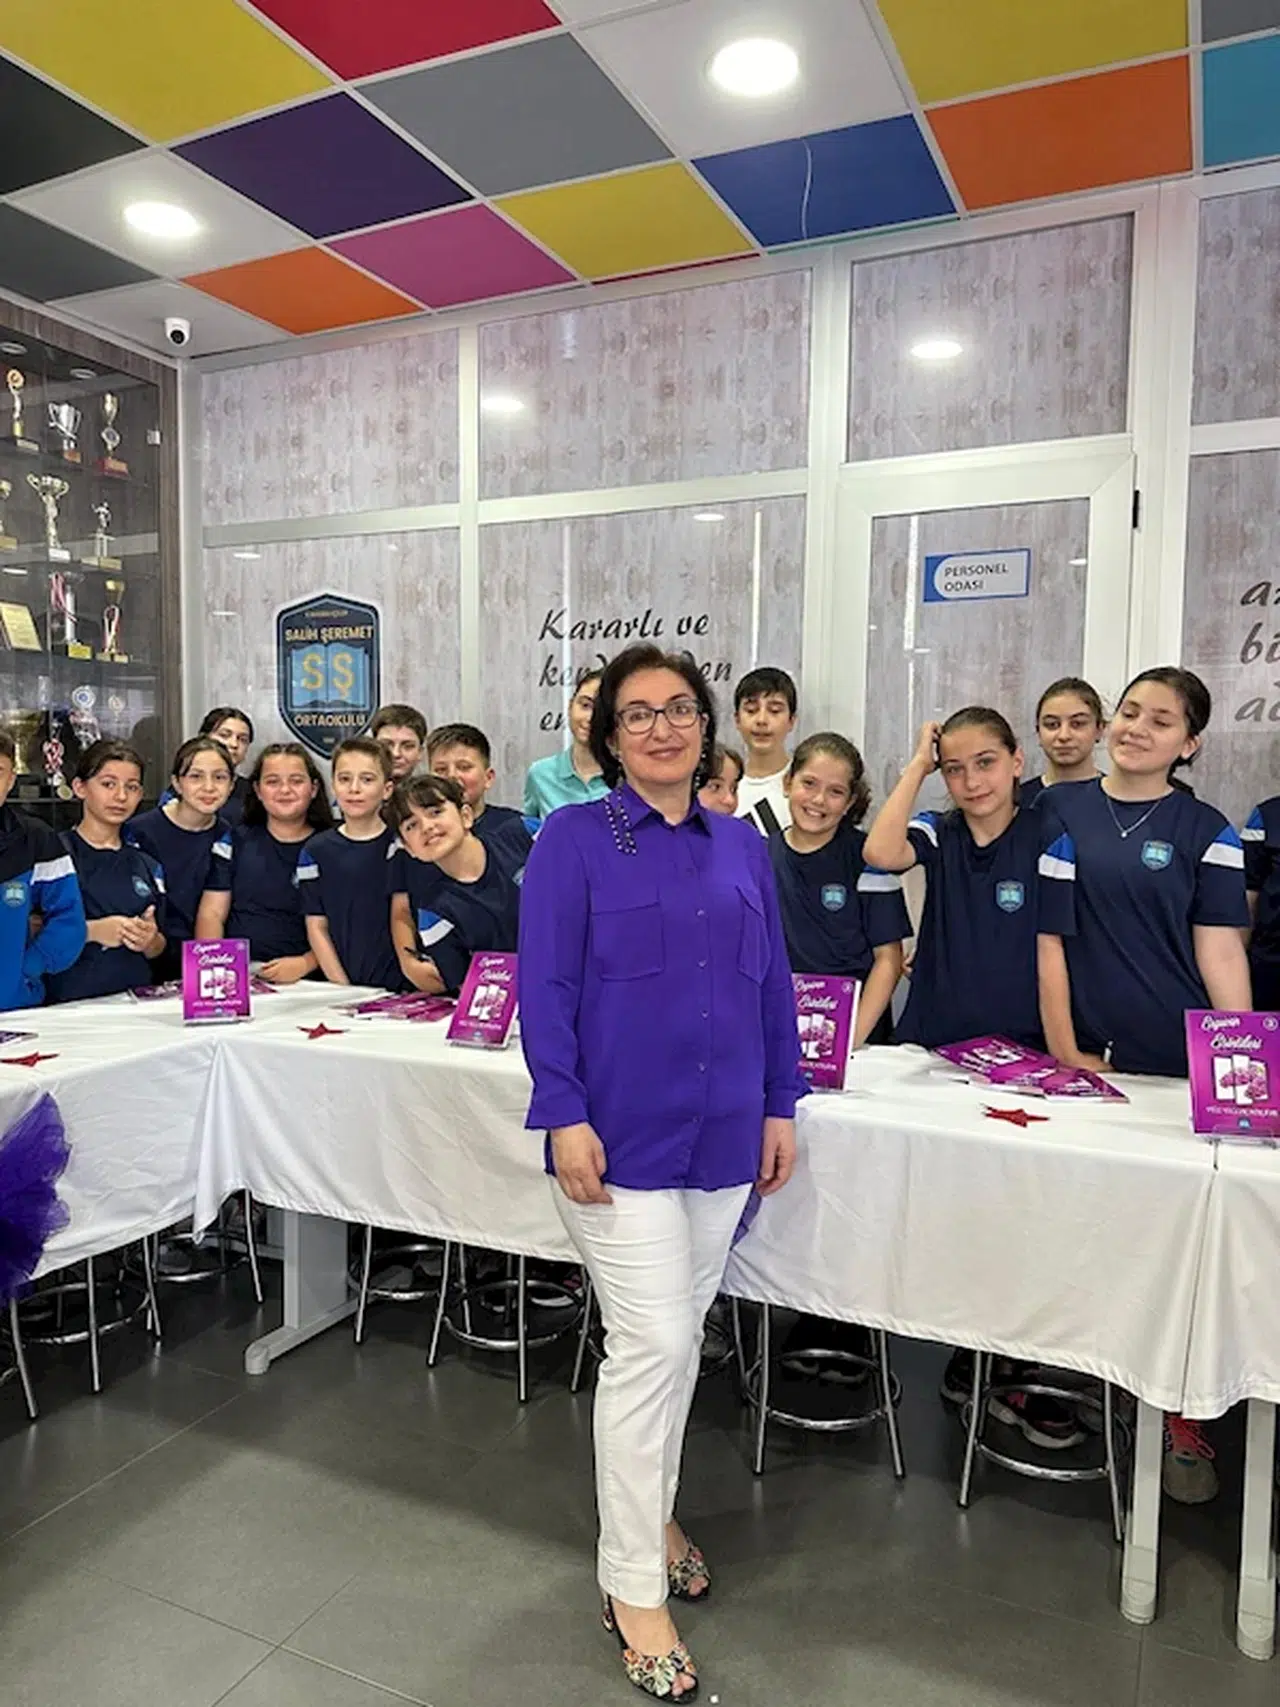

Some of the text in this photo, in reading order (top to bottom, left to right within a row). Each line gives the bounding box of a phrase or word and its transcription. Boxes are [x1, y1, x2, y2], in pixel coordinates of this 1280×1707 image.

[944, 563, 1009, 577] PERSONEL
[944, 580, 984, 592] ODASI
[539, 608, 709, 641] Kararlı ve
[320, 625, 373, 643] ŞEREMET
[294, 713, 365, 727] ORTAOKULU
